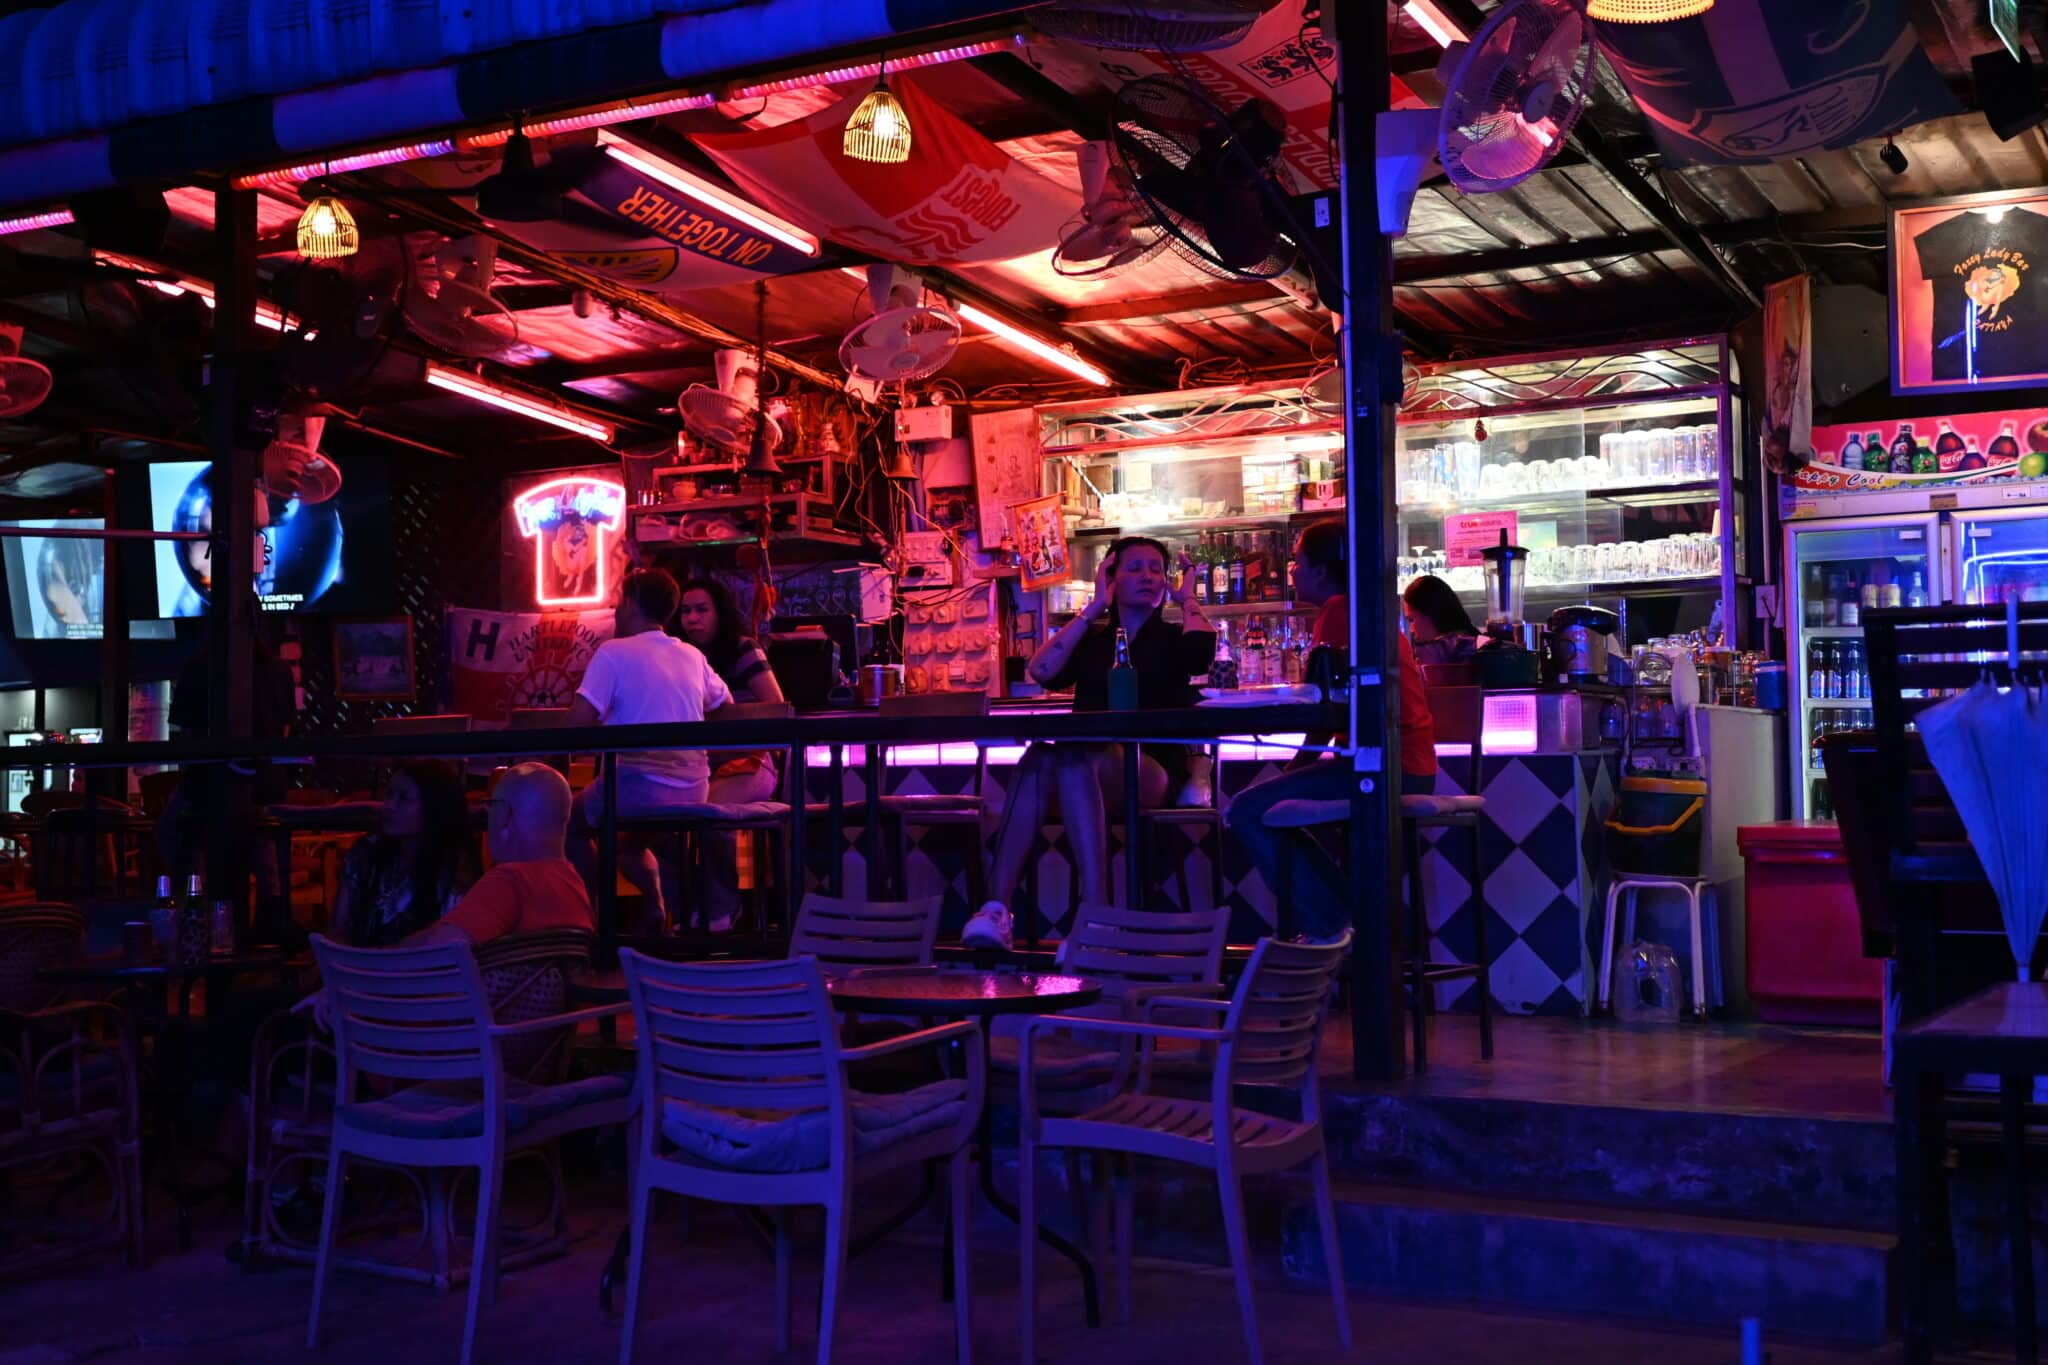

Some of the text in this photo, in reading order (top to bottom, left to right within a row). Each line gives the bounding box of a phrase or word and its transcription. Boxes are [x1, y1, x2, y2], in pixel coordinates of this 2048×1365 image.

[617, 185, 774, 265] ON TOGETHER
[1795, 468, 1884, 486] appy Cool
[465, 619, 500, 661] H
[509, 620, 601, 651] HARTLEPOOL
